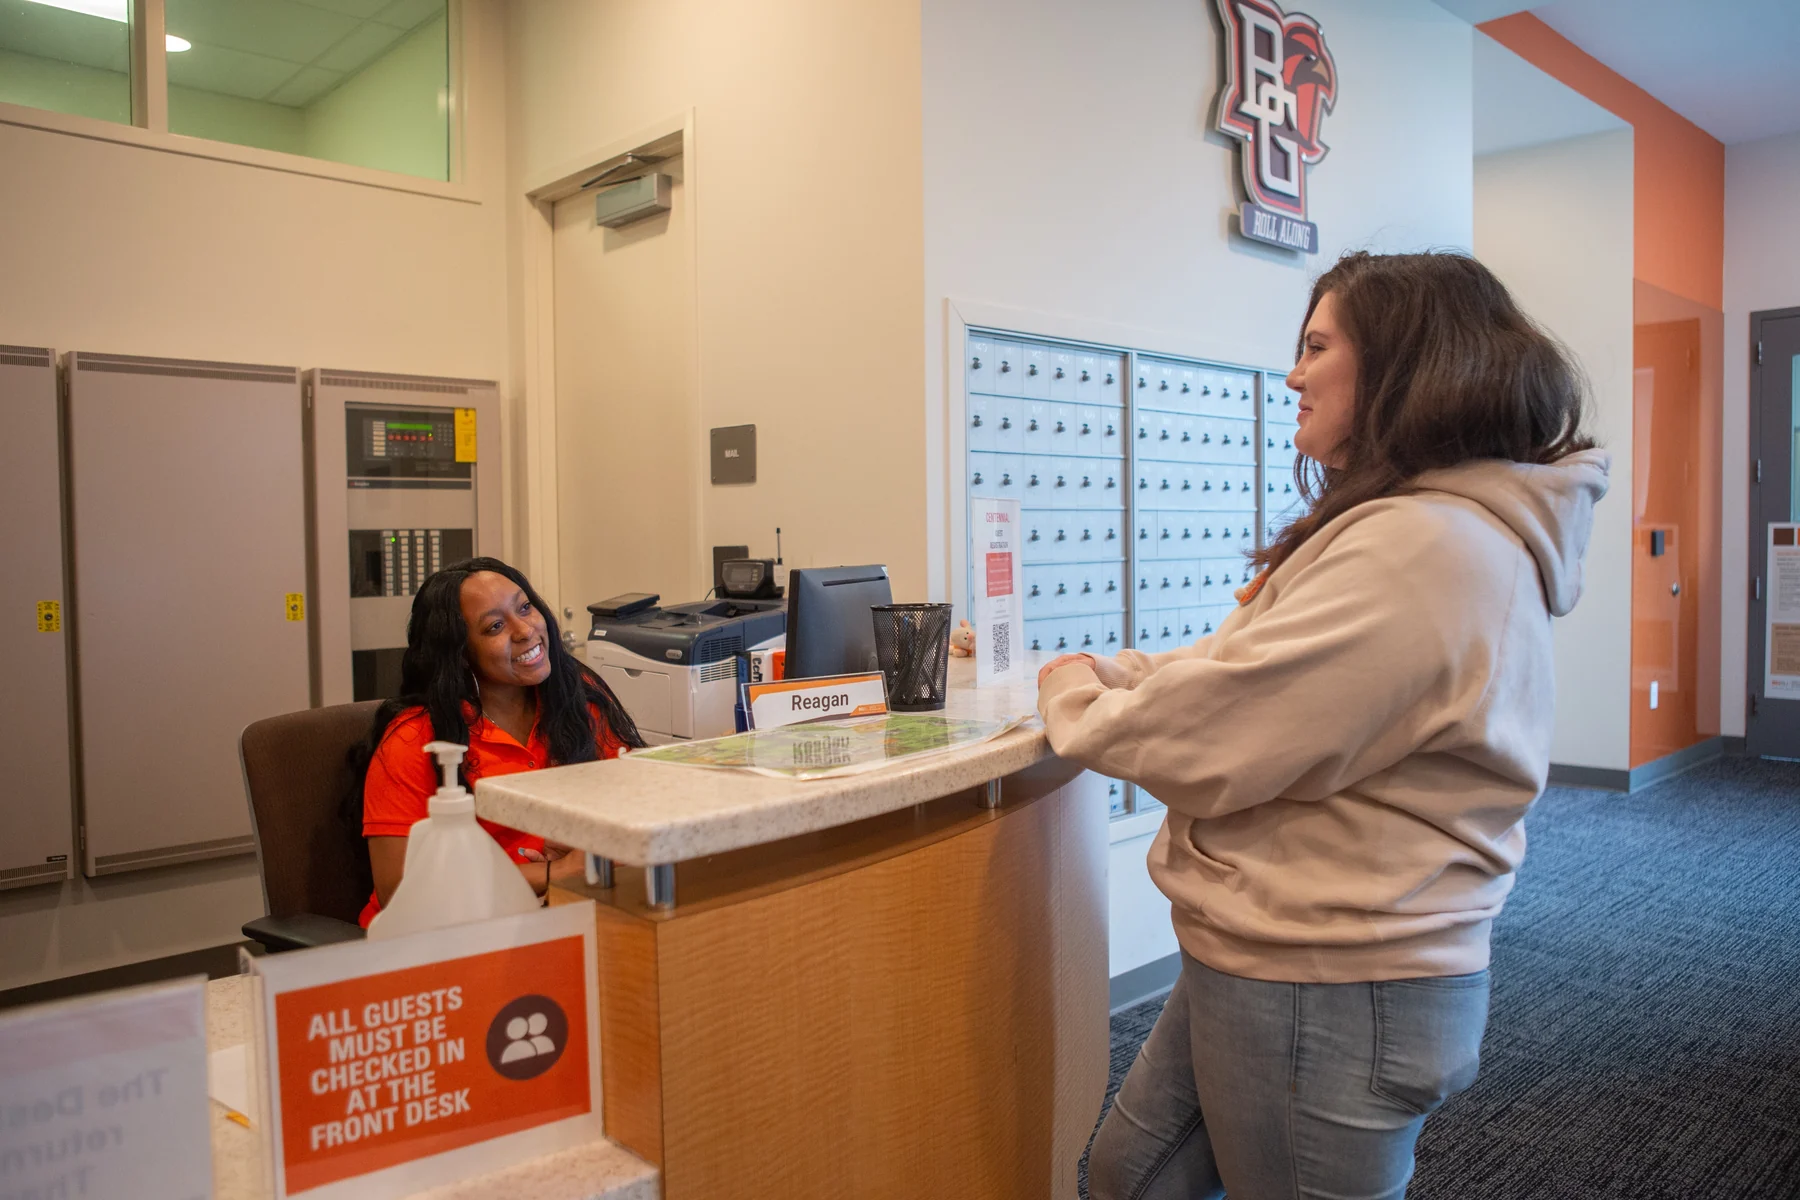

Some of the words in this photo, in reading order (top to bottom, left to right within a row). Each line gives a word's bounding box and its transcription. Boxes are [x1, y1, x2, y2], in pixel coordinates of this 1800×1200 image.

[1253, 210, 1277, 240] ROLL
[1278, 218, 1311, 250] ALONG
[724, 449, 740, 459] MAIL
[791, 693, 849, 712] Reagan
[308, 1009, 357, 1040] ALL
[364, 986, 463, 1028] GUESTS
[330, 1024, 407, 1063] MUST
[414, 1016, 446, 1045] BE
[311, 1046, 431, 1096] CHECKED
[438, 1038, 465, 1065] IN
[346, 1084, 380, 1114] AT
[387, 1071, 436, 1103] THE
[311, 1106, 398, 1151] FRONT
[406, 1088, 471, 1127] DESK
